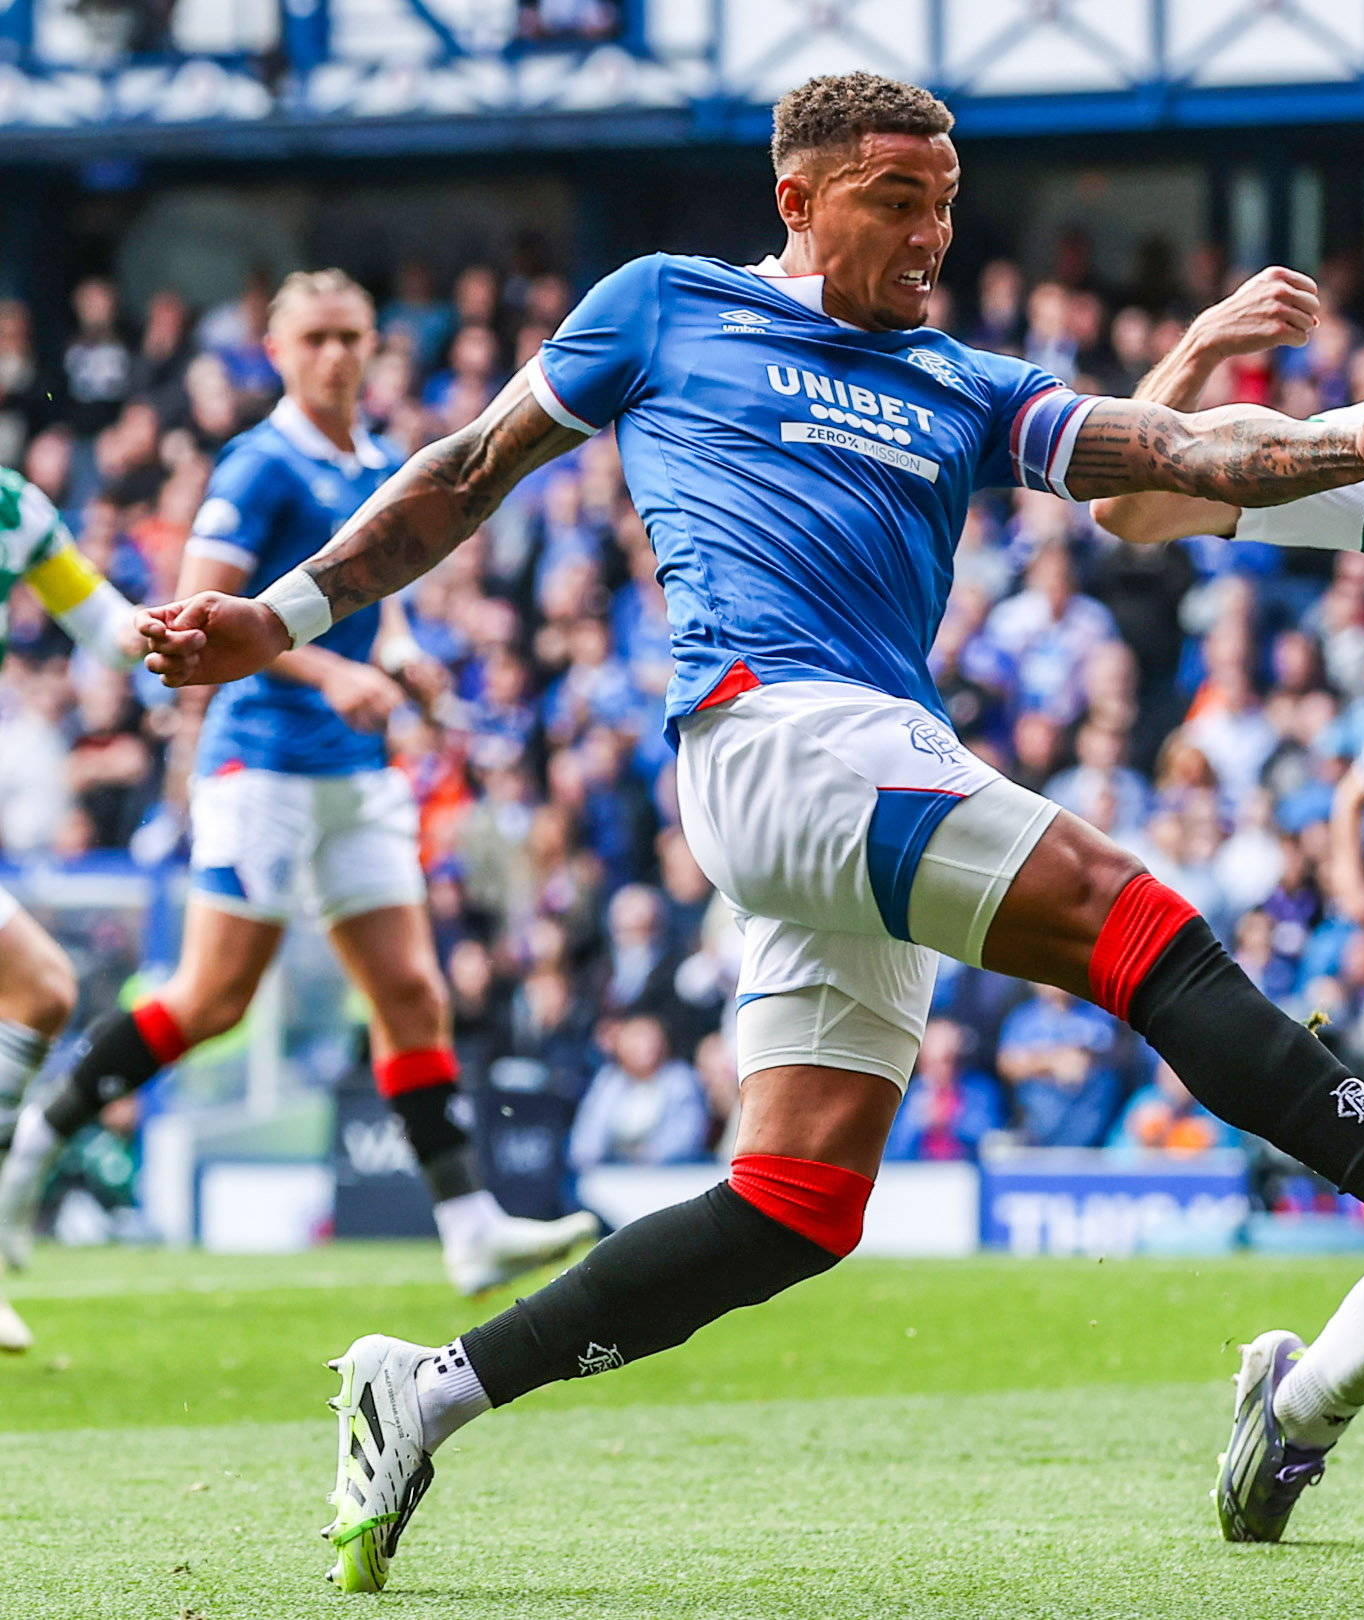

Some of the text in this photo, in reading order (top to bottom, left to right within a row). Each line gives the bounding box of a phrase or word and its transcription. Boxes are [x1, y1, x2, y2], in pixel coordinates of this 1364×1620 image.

[722, 324, 766, 334] umbro
[766, 365, 934, 433] UNIBET
[807, 427, 921, 471] ZERO% MISSION
